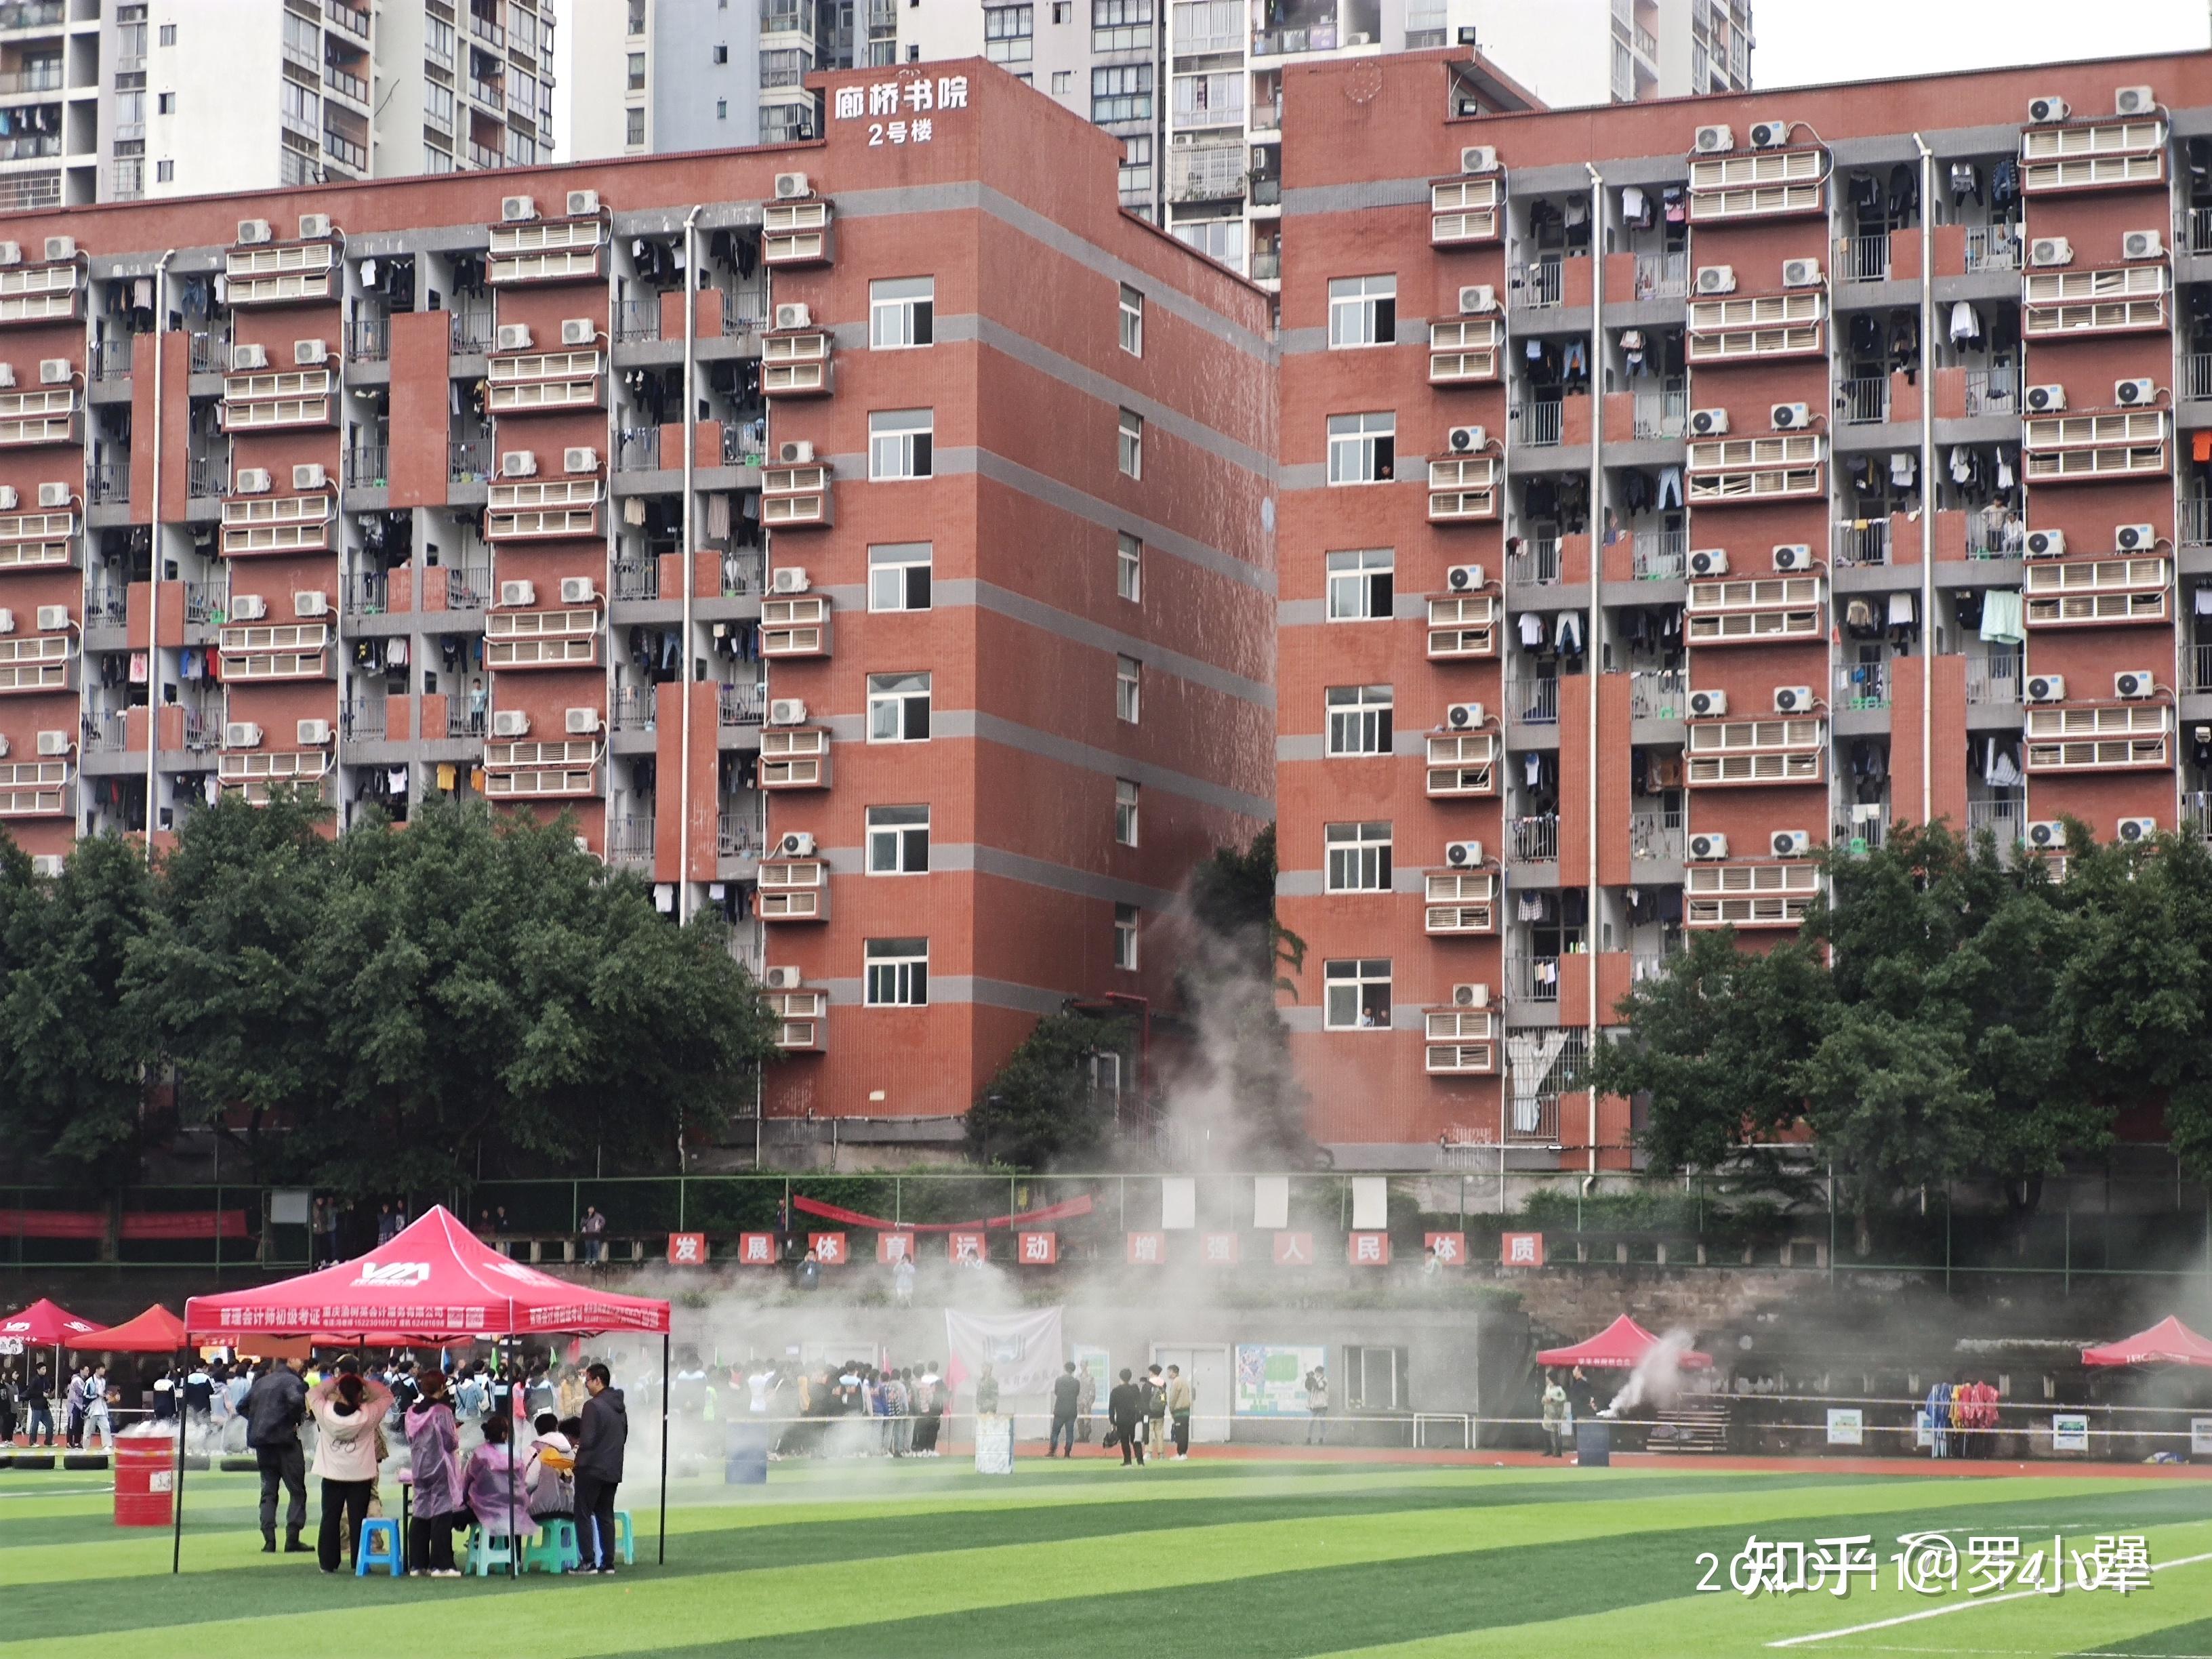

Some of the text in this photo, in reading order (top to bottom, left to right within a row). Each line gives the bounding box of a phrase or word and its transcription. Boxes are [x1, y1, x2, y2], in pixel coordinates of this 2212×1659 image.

[835, 75, 968, 119] 廊桥书院
[868, 118, 933, 146] 2号楼
[676, 1236, 697, 1261] 发
[747, 1236, 768, 1259] 展
[816, 1236, 838, 1261] 体
[1026, 1235, 1048, 1259] 动
[1283, 1236, 1303, 1259] 人
[1357, 1236, 1380, 1261] 民
[1511, 1237, 1534, 1261] 质
